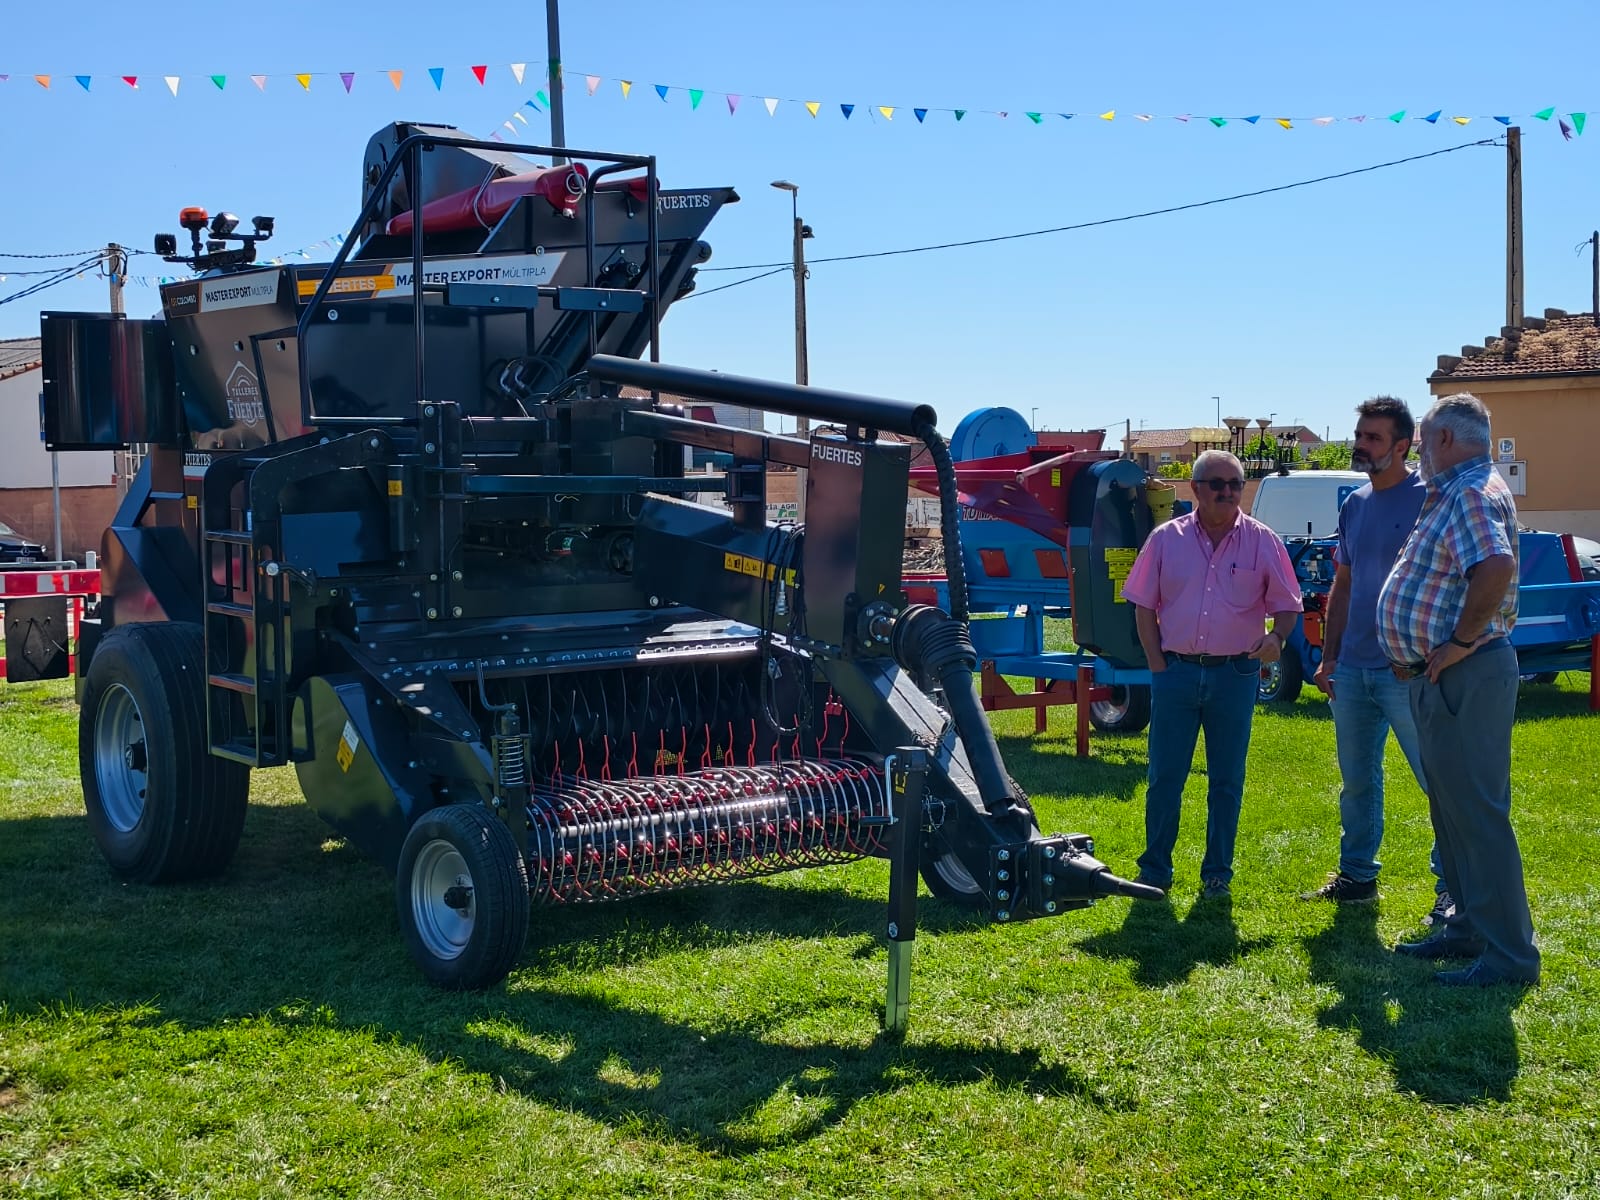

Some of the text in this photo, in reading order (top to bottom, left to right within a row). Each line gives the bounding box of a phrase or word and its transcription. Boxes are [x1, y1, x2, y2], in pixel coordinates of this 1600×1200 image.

[657, 194, 710, 214] FUERTES
[396, 266, 546, 287] MATER EXPORT MÚLTIPLA
[205, 290, 229, 303] MASTER
[228, 286, 251, 300] EXPORT
[226, 399, 265, 419] FUERTE
[184, 453, 210, 466] FUERTES
[812, 443, 862, 466] FUERTES
